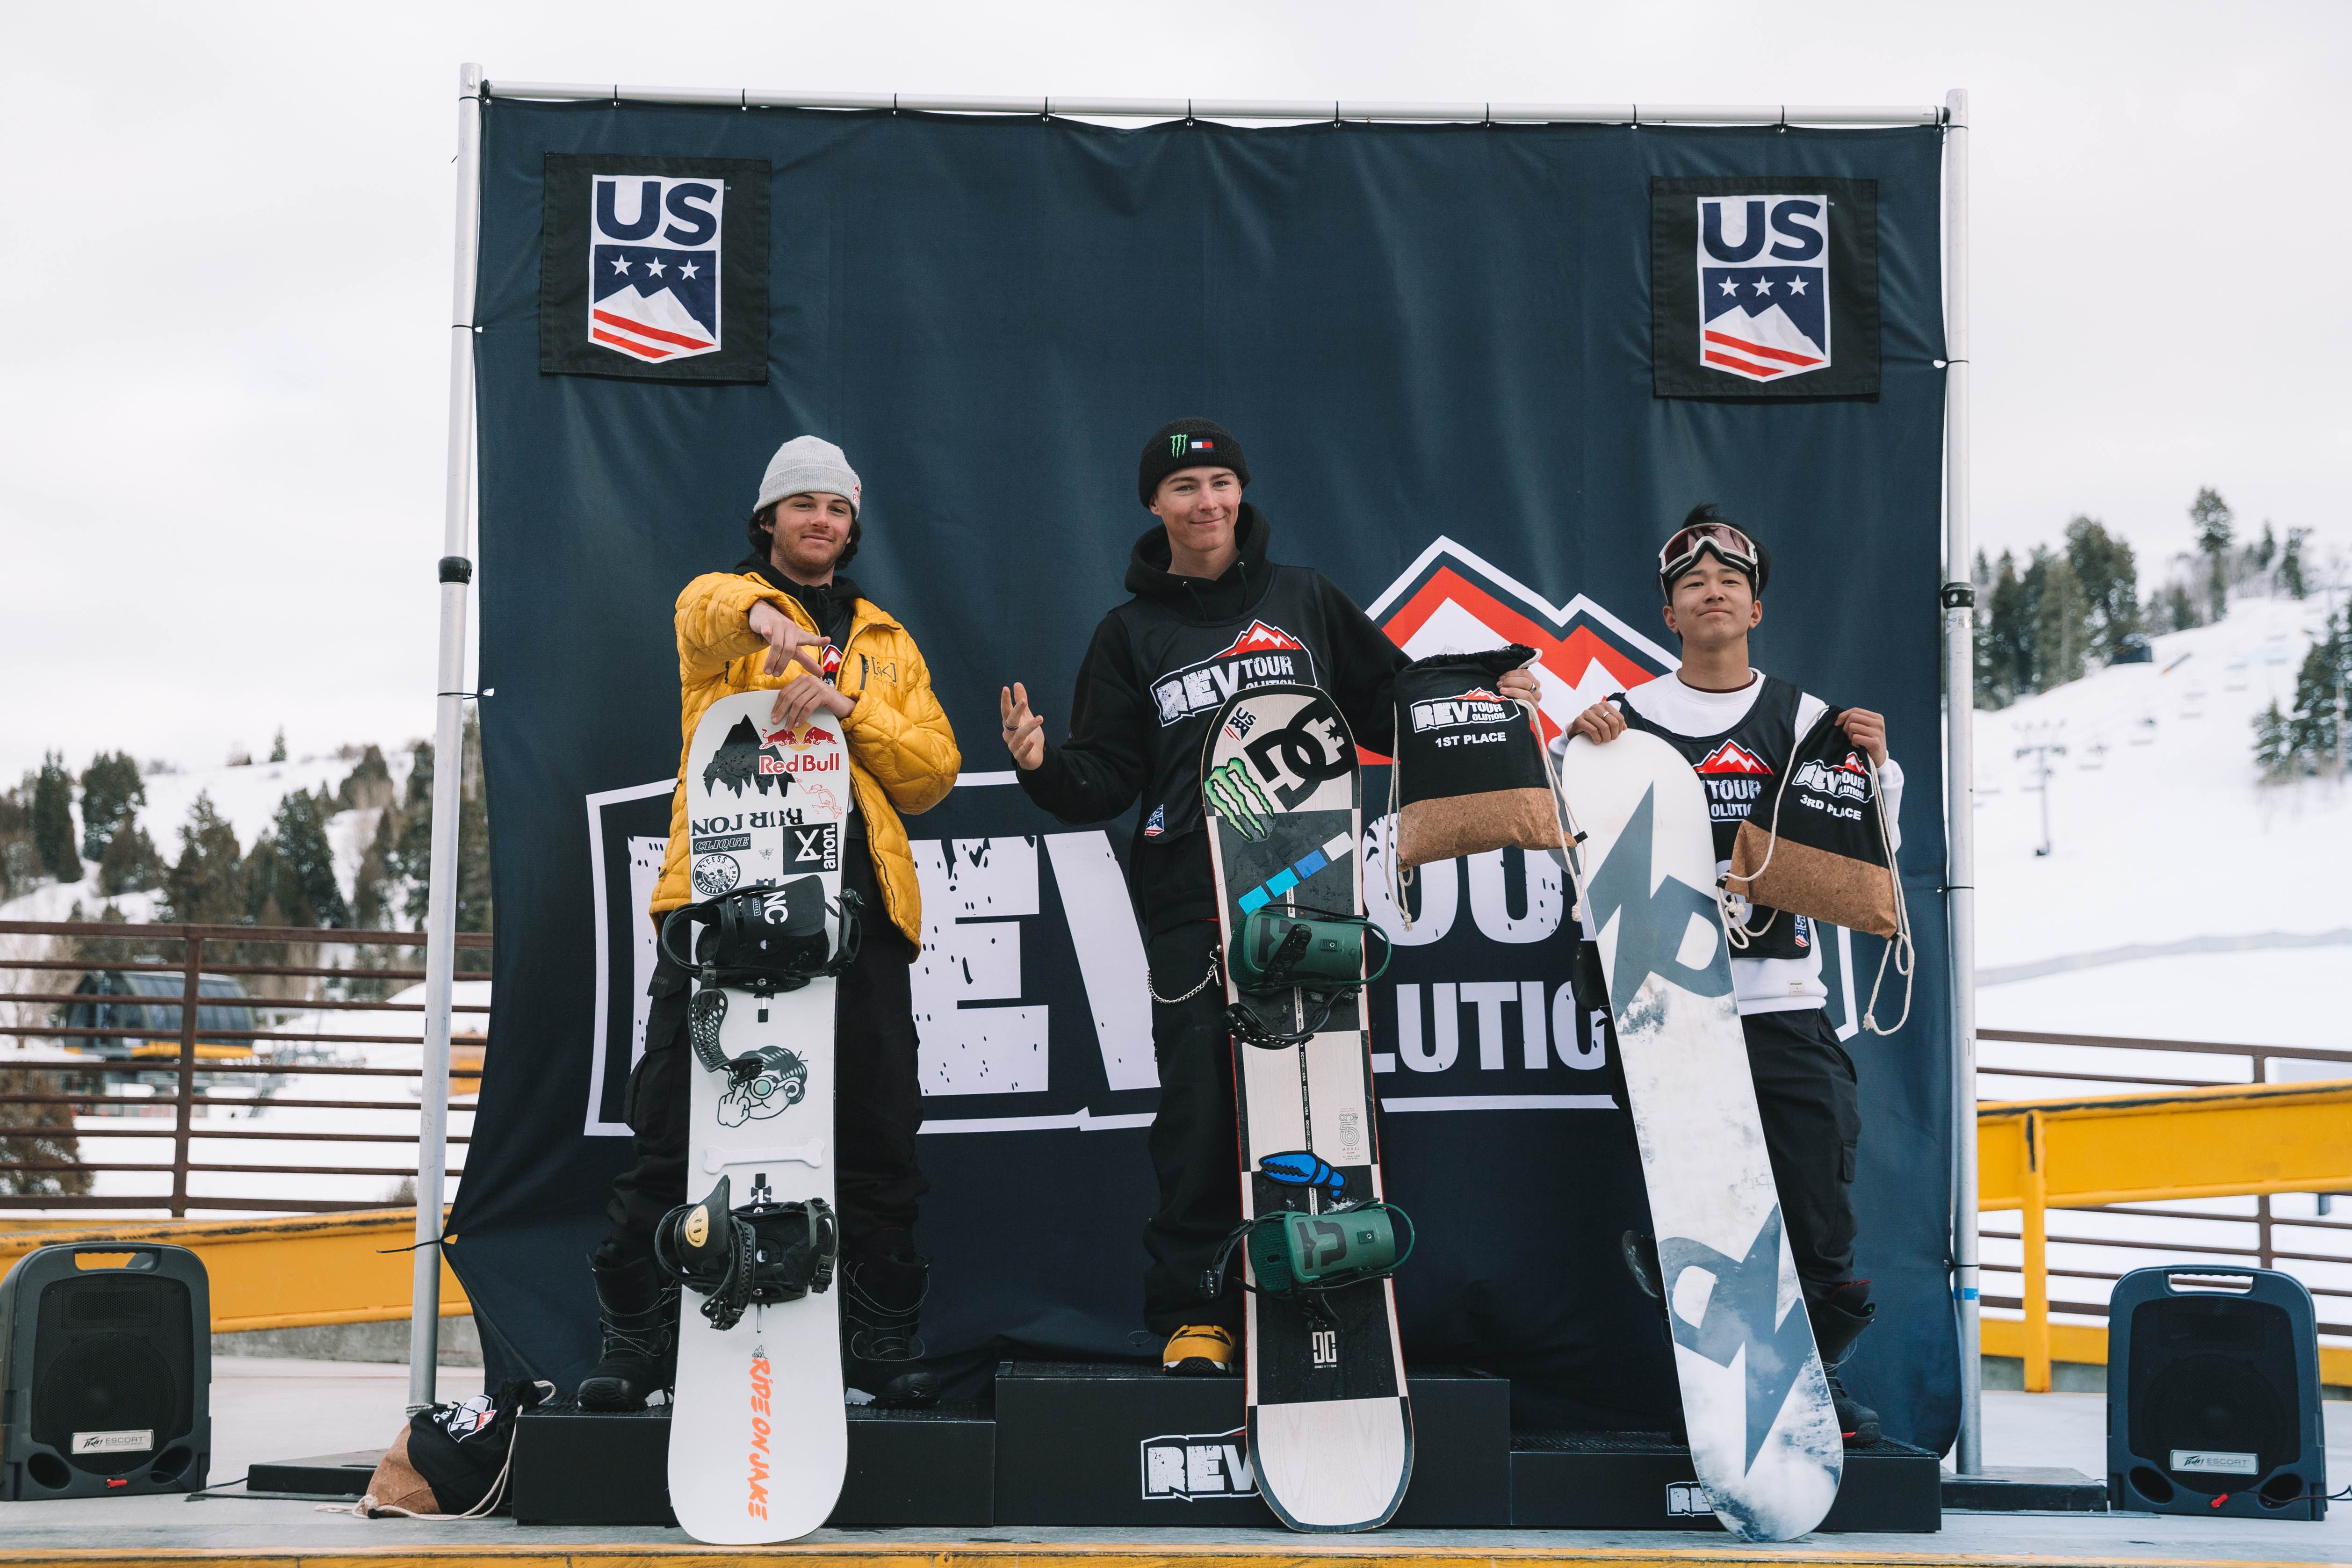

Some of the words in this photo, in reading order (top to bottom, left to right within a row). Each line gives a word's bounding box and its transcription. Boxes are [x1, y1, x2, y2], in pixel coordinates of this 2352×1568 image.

[597, 181, 717, 246] US
[1703, 200, 1823, 263] US
[873, 675, 897, 688] BUTON
[1156, 661, 1239, 721] REV
[1240, 656, 1294, 679] TOUR
[1236, 707, 1257, 726] US
[1414, 702, 1469, 729] REV
[1469, 702, 1503, 713] TOUR
[1472, 712, 1506, 721] OLUTION
[1436, 736, 1460, 748] 1ST
[1464, 732, 1507, 744] PLACE
[760, 754, 798, 773] Red
[802, 752, 840, 772] Bull
[1706, 780, 1761, 800] TOUR
[1796, 764, 1842, 794] REV
[1840, 772, 1866, 790] OUR
[1710, 803, 1752, 817] OLUTI
[1800, 794, 1825, 809] 3RD
[1827, 803, 1862, 821] PLACE
[695, 836, 750, 852] CLIQUE
[823, 824, 837, 869] anon.
[700, 883, 719, 894] SKATE
[763, 890, 788, 925] NC
[1796, 915, 1805, 926] US
[750, 1416, 771, 1454] ON
[1147, 1445, 1255, 1493] REV
[747, 1452, 770, 1521] JAKE
[1670, 1487, 1712, 1512] RE
